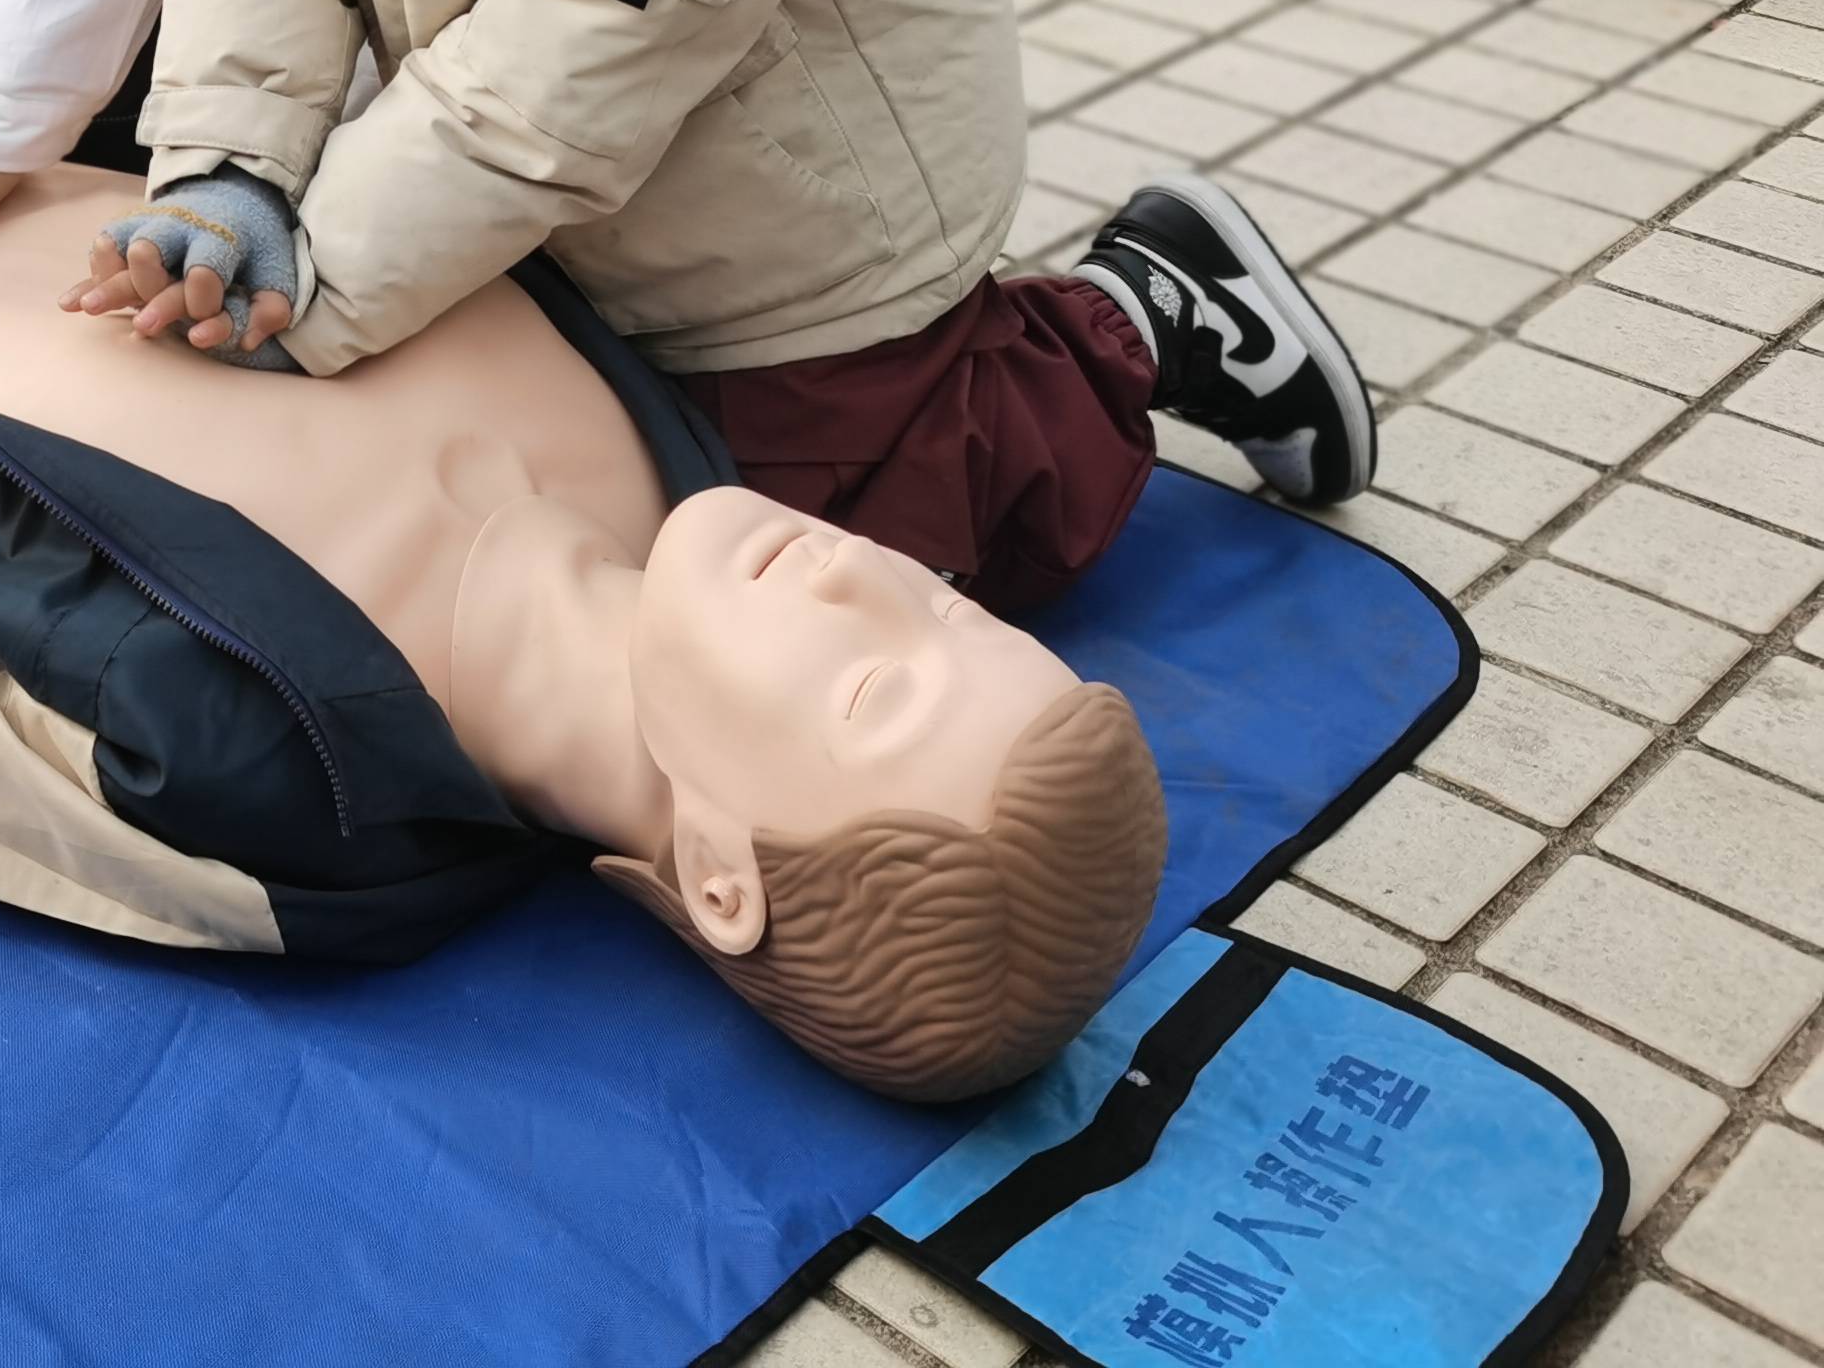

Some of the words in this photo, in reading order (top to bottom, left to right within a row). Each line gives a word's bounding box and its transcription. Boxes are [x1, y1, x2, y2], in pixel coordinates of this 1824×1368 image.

[1123, 1055, 1430, 1368] 模拟人操作垫
